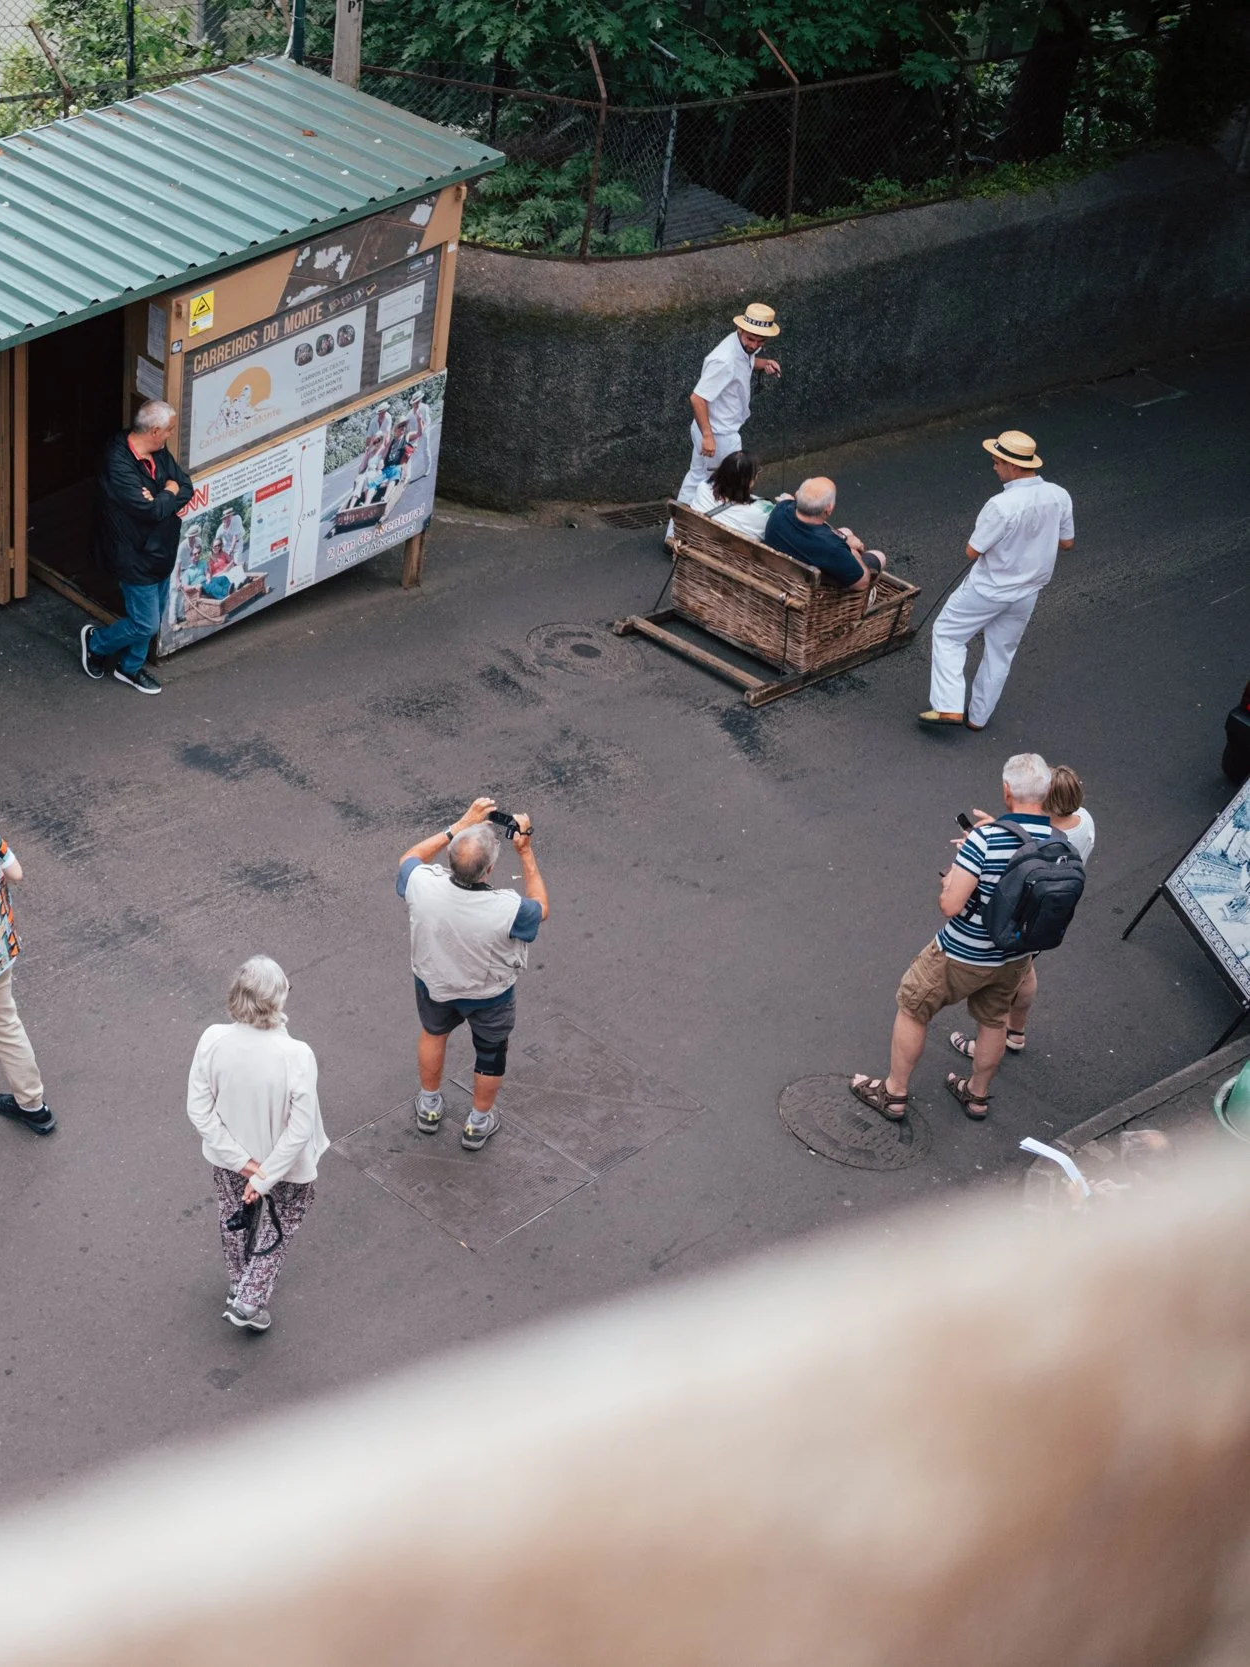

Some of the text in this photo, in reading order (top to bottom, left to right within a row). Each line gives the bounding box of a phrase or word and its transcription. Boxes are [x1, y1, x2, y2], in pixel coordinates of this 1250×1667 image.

[193, 330, 258, 373] CARREIROS
[262, 321, 279, 344] DO
[283, 302, 324, 334] MONTE
[327, 547, 335, 560] 2
[337, 540, 355, 556] Km
[358, 531, 372, 545] de
[374, 502, 426, 537] Aventura!
[335, 522, 417, 569] 2 km of Adventure!
